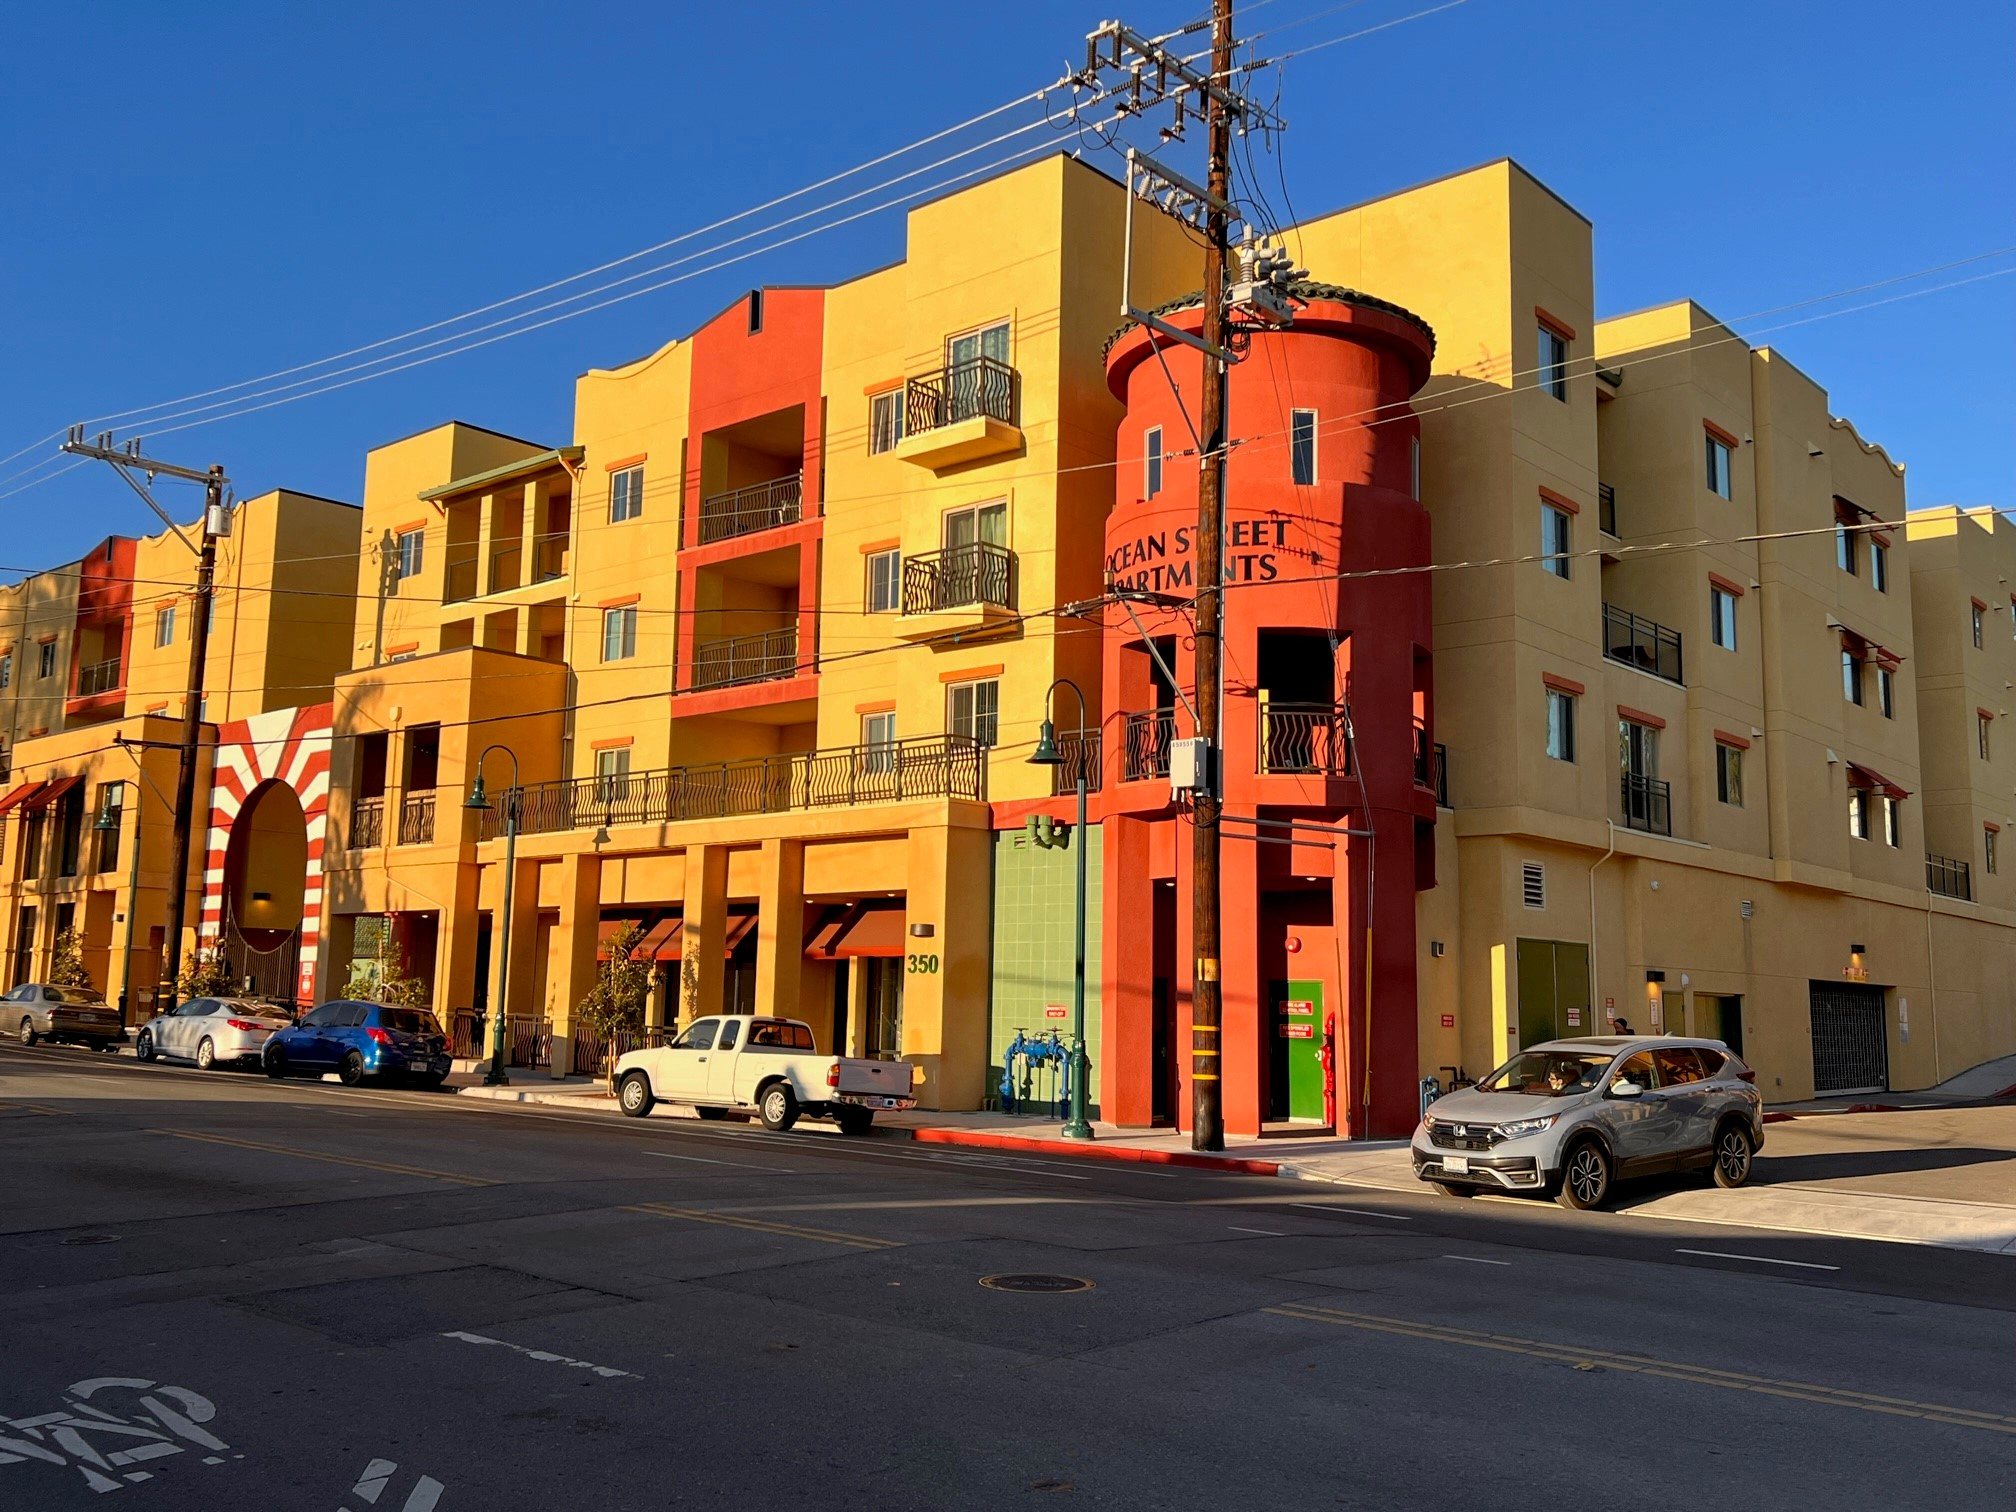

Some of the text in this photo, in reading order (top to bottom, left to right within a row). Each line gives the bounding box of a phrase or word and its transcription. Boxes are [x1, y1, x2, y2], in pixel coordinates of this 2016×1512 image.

[1105, 519, 1292, 576] OCEAN SEET
[1107, 553, 1278, 608] PARTMNTS
[907, 954, 939, 974] 350
